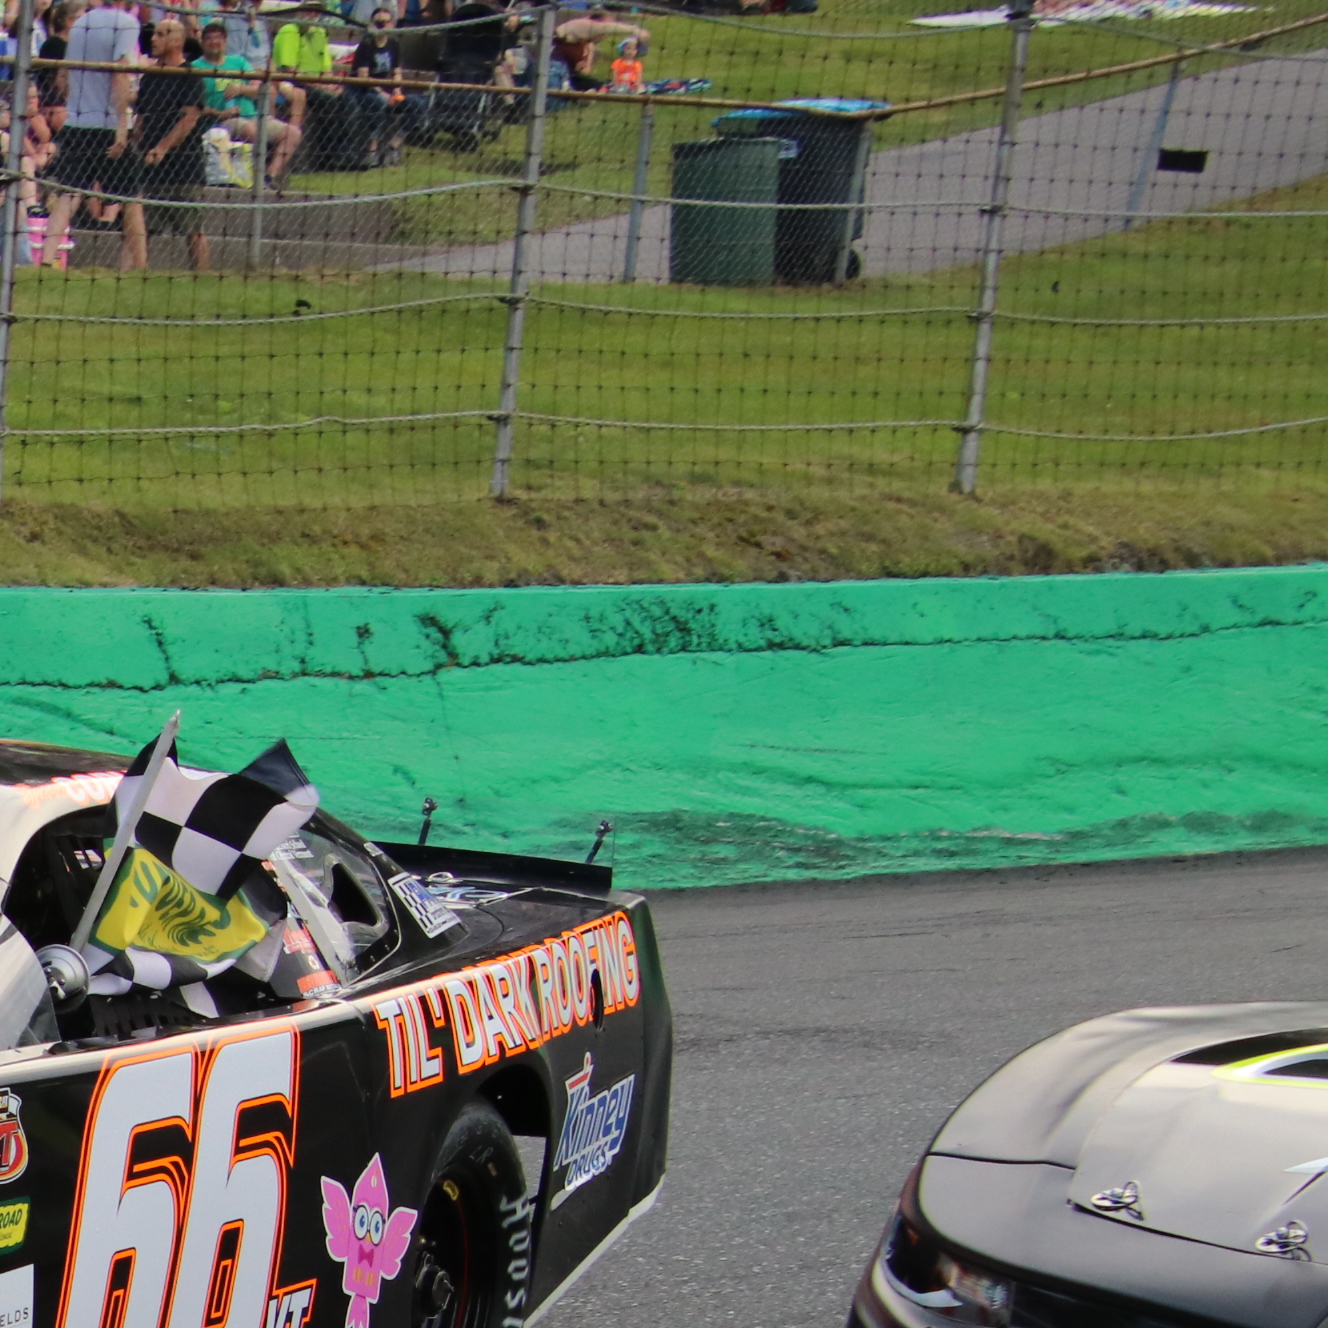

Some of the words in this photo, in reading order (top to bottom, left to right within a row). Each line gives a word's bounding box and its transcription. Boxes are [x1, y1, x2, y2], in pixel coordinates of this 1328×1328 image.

[443, 952, 540, 1070] DARK
[528, 915, 640, 1035] ROOFING
[553, 1077, 634, 1170] Kinney
[565, 1143, 609, 1188] DRUGS
